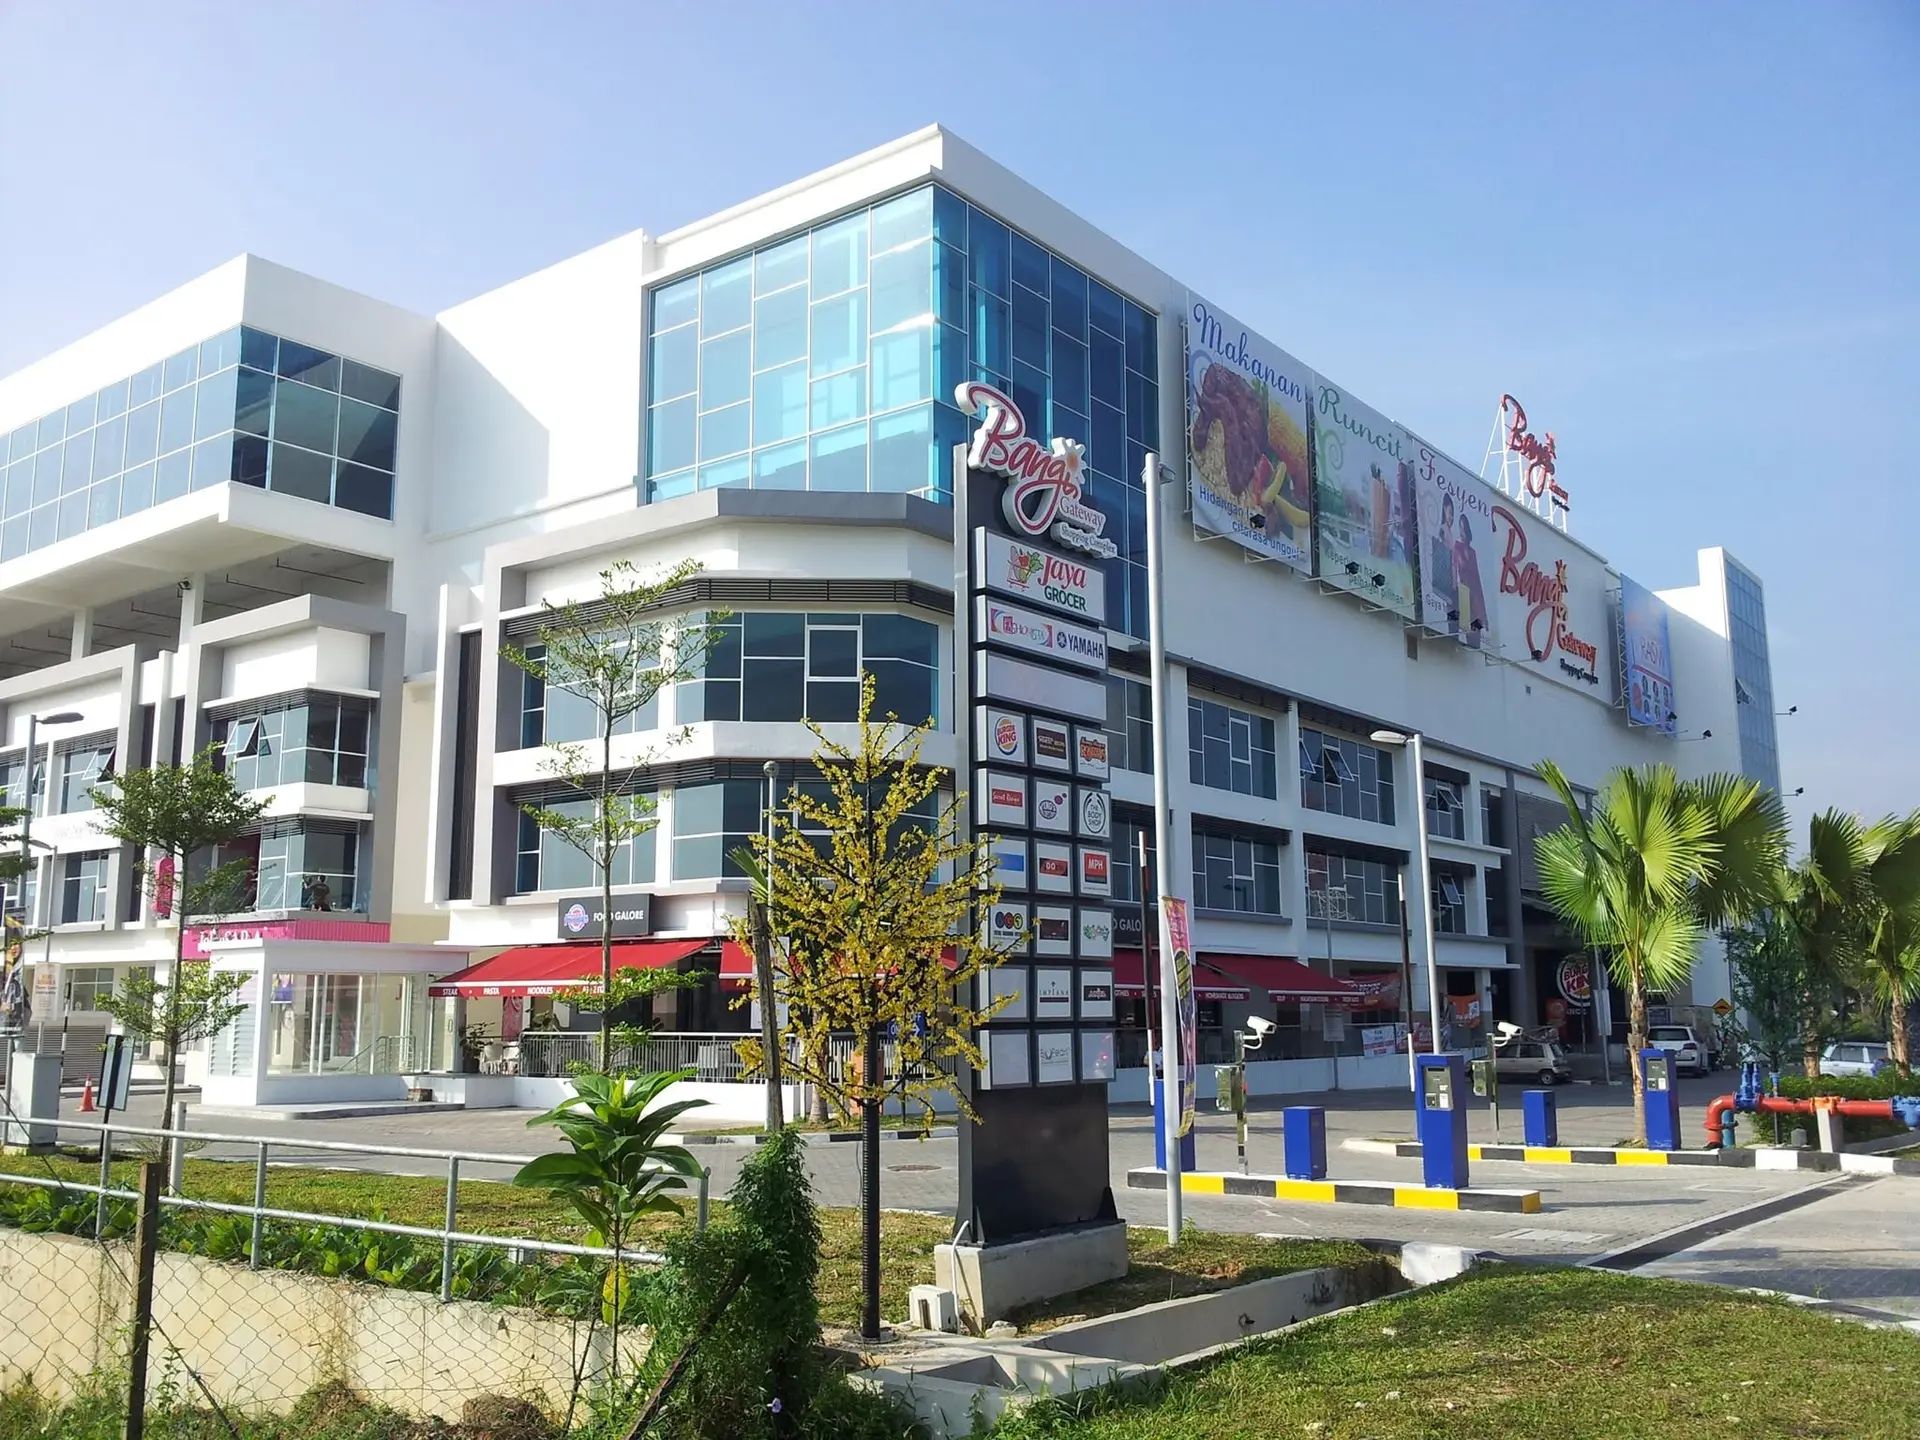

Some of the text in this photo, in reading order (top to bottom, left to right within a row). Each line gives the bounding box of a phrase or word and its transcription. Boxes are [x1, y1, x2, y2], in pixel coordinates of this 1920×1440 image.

[1193, 302, 1303, 404] Makanan
[1318, 384, 1403, 462] Runcit
[967, 384, 1081, 532] Bangi
[1419, 447, 1490, 517] Fesyen
[1060, 497, 1105, 531] Gateway
[1037, 554, 1087, 591] Jaya
[1491, 505, 1568, 662] Bangi
[1044, 586, 1087, 612] GROCER
[1068, 633, 1105, 661] YAMAHA
[1556, 622, 1597, 673] Gateway
[998, 732, 1017, 746] KING
[1088, 858, 1103, 871] MPH
[614, 909, 644, 921] GALORE
[1119, 919, 1142, 932] GALO
[442, 986, 553, 996] STEAK PASTA NOODLES
